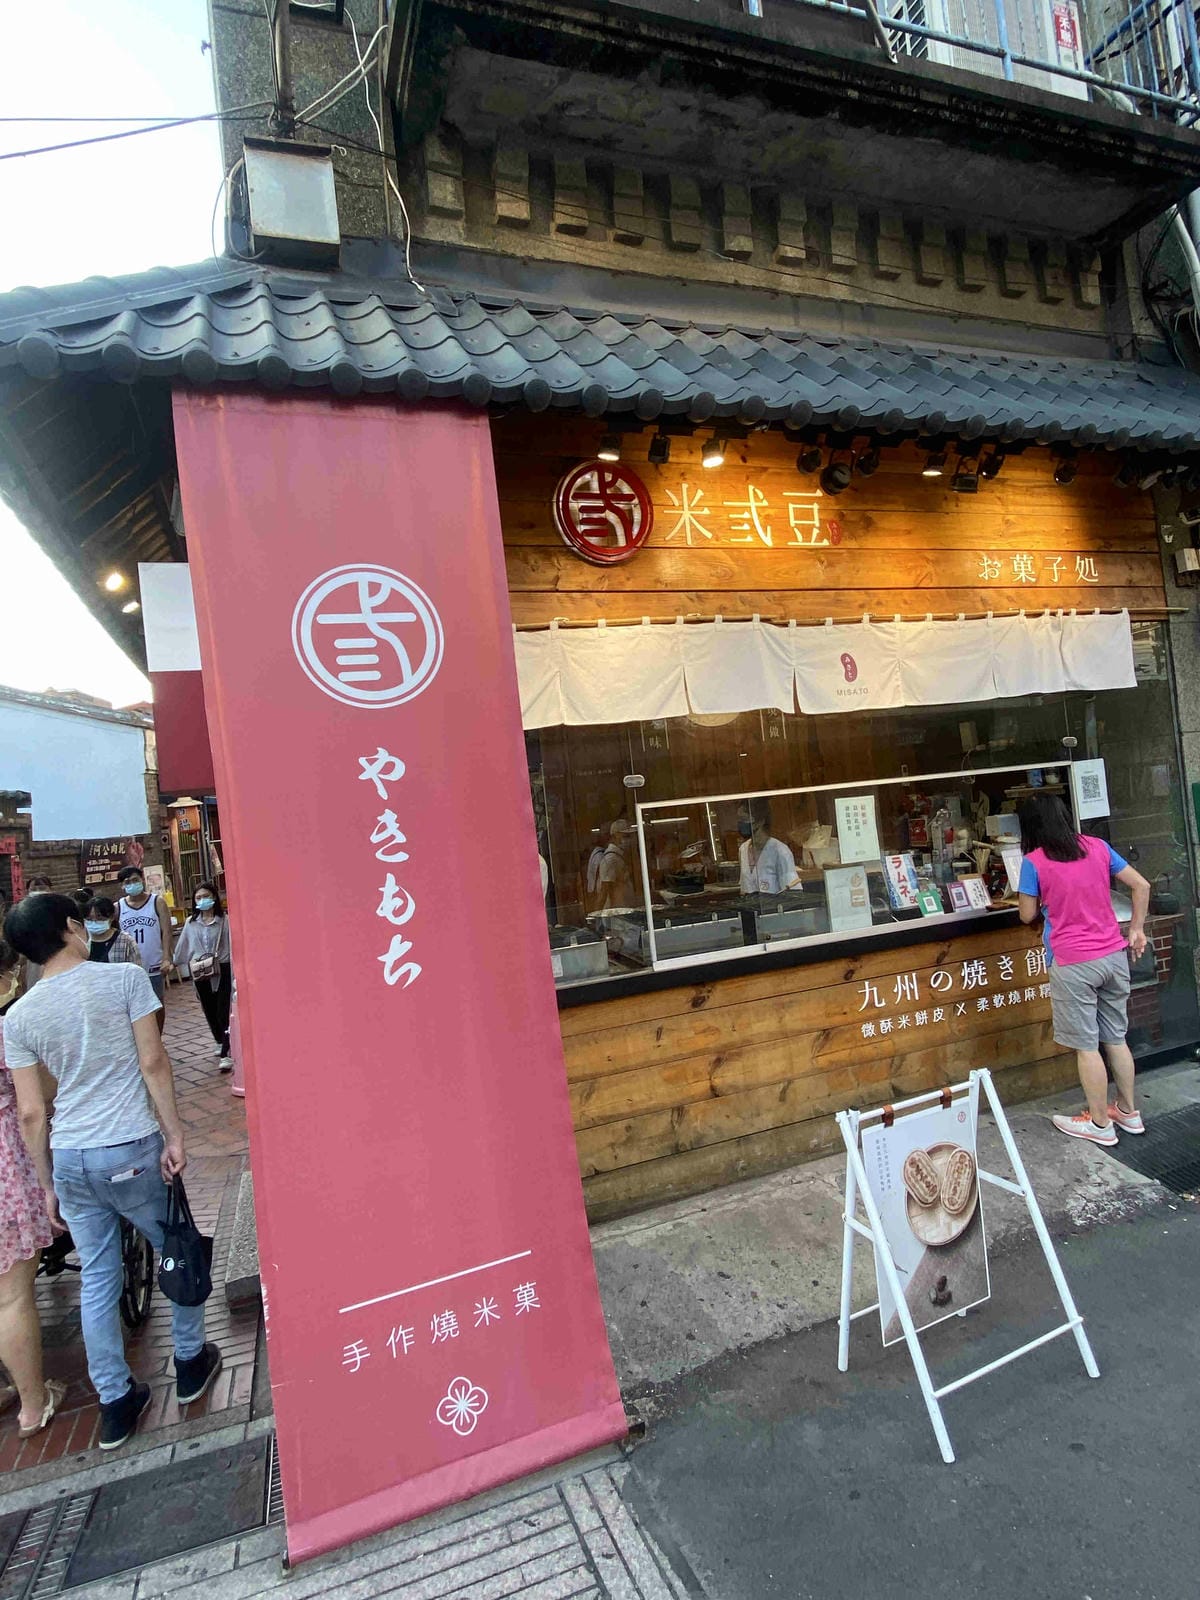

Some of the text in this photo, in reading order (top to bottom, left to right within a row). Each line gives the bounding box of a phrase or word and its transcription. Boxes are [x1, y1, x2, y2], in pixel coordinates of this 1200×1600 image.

[978, 553, 1099, 583] お菓子処
[836, 687, 869, 697] MISATO
[358, 747, 422, 990] やきもち
[891, 856, 910, 898] ラムネ
[134, 928, 145, 944] 11
[341, 1281, 541, 1373] 手作燒米菓
